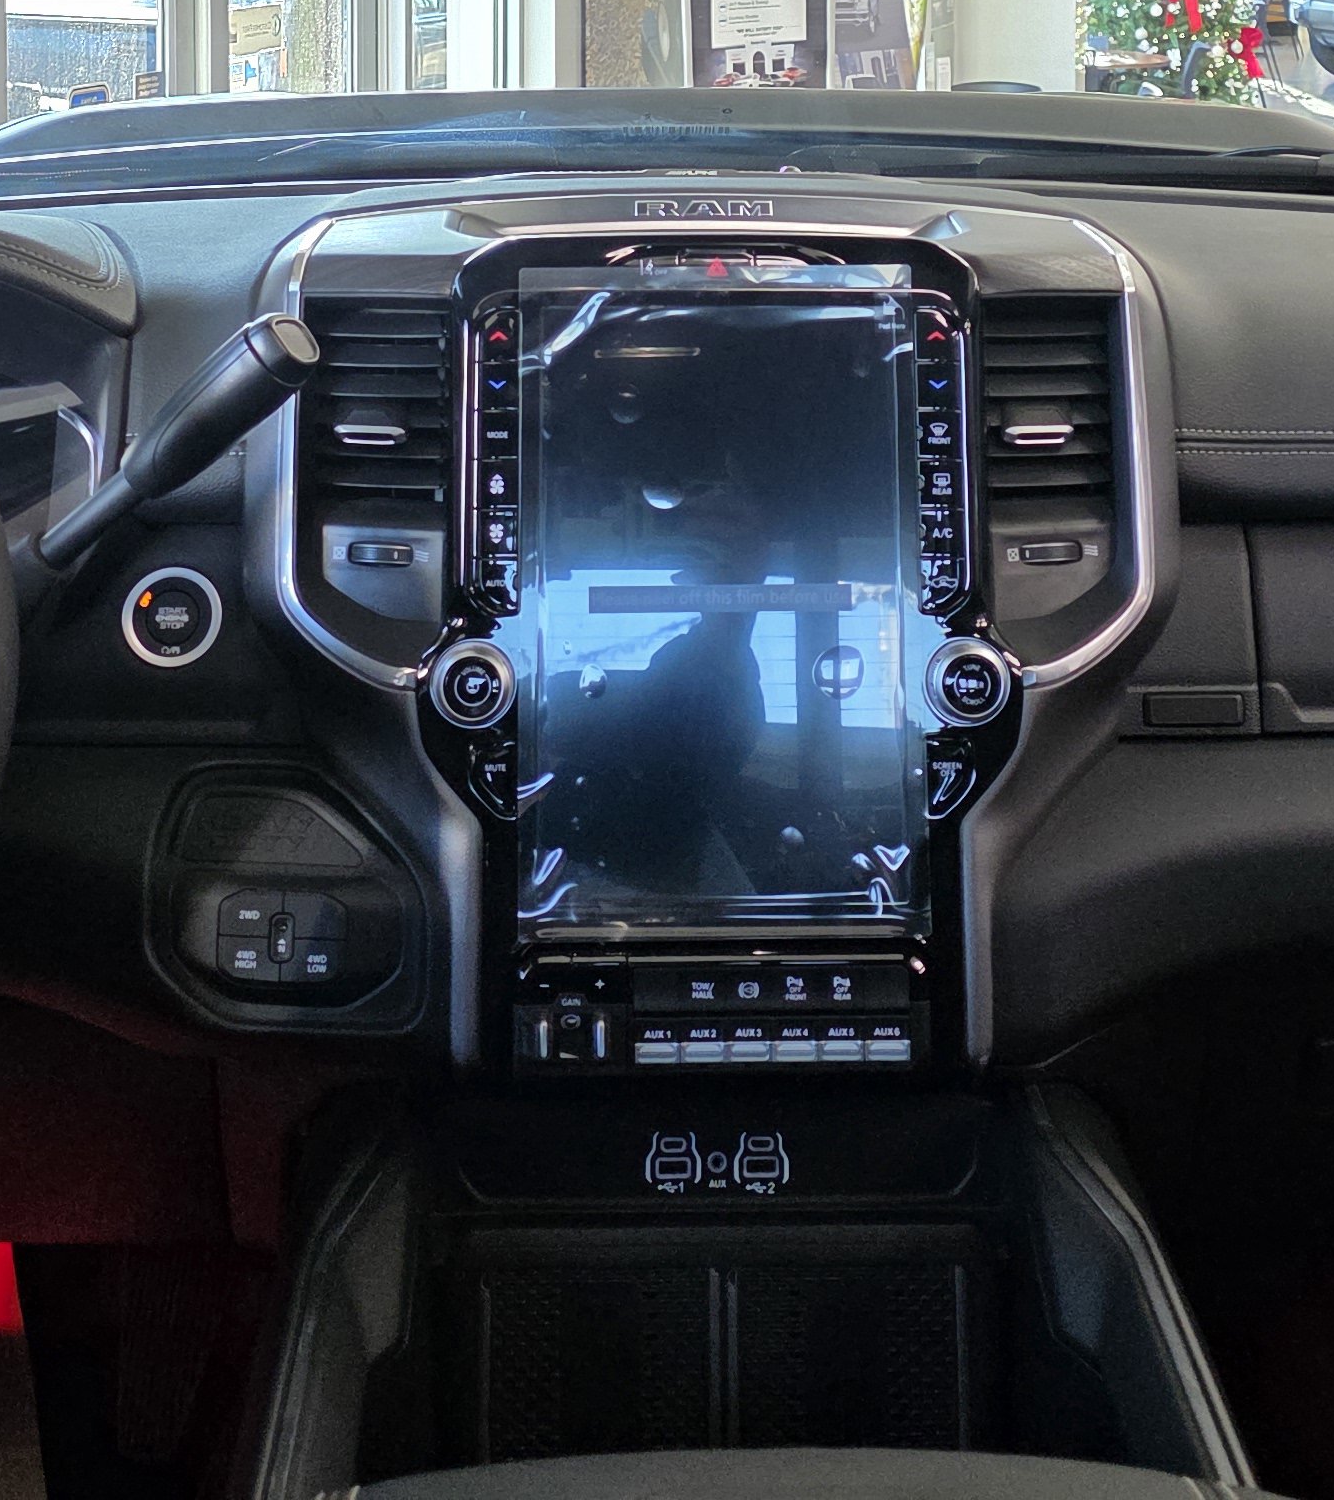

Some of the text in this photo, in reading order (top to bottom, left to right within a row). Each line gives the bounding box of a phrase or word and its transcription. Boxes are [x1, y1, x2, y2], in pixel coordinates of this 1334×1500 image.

[635, 200, 773, 217] RAM
[928, 437, 951, 445] FRONT
[933, 528, 953, 539] A/C
[679, 590, 701, 605] off
[704, 589, 732, 605] this
[736, 589, 764, 604] film
[770, 589, 818, 604] before
[159, 622, 185, 630] STOP
[932, 762, 962, 770] SCREEN
[940, 769, 956, 777] OFF
[239, 910, 260, 920] 2WD
[236, 950, 256, 960] 4WD
[307, 954, 327, 964] 4WD
[235, 960, 257, 969] HIGH
[307, 964, 327, 974] LOW
[691, 981, 715, 991] TOW/
[692, 991, 715, 999] HAUL
[561, 998, 581, 1006] GAIN
[645, 1030, 671, 1038] AUX 1
[691, 1030, 717, 1038] AUX 2
[735, 1029, 762, 1037] AUX 3
[782, 1029, 808, 1037] AUX 4
[828, 1028, 854, 1036] AUX 5
[874, 1028, 900, 1036] AUX 6
[679, 1182, 684, 1193] 1
[709, 1180, 726, 1188] AUX
[768, 1182, 775, 1194] 2
